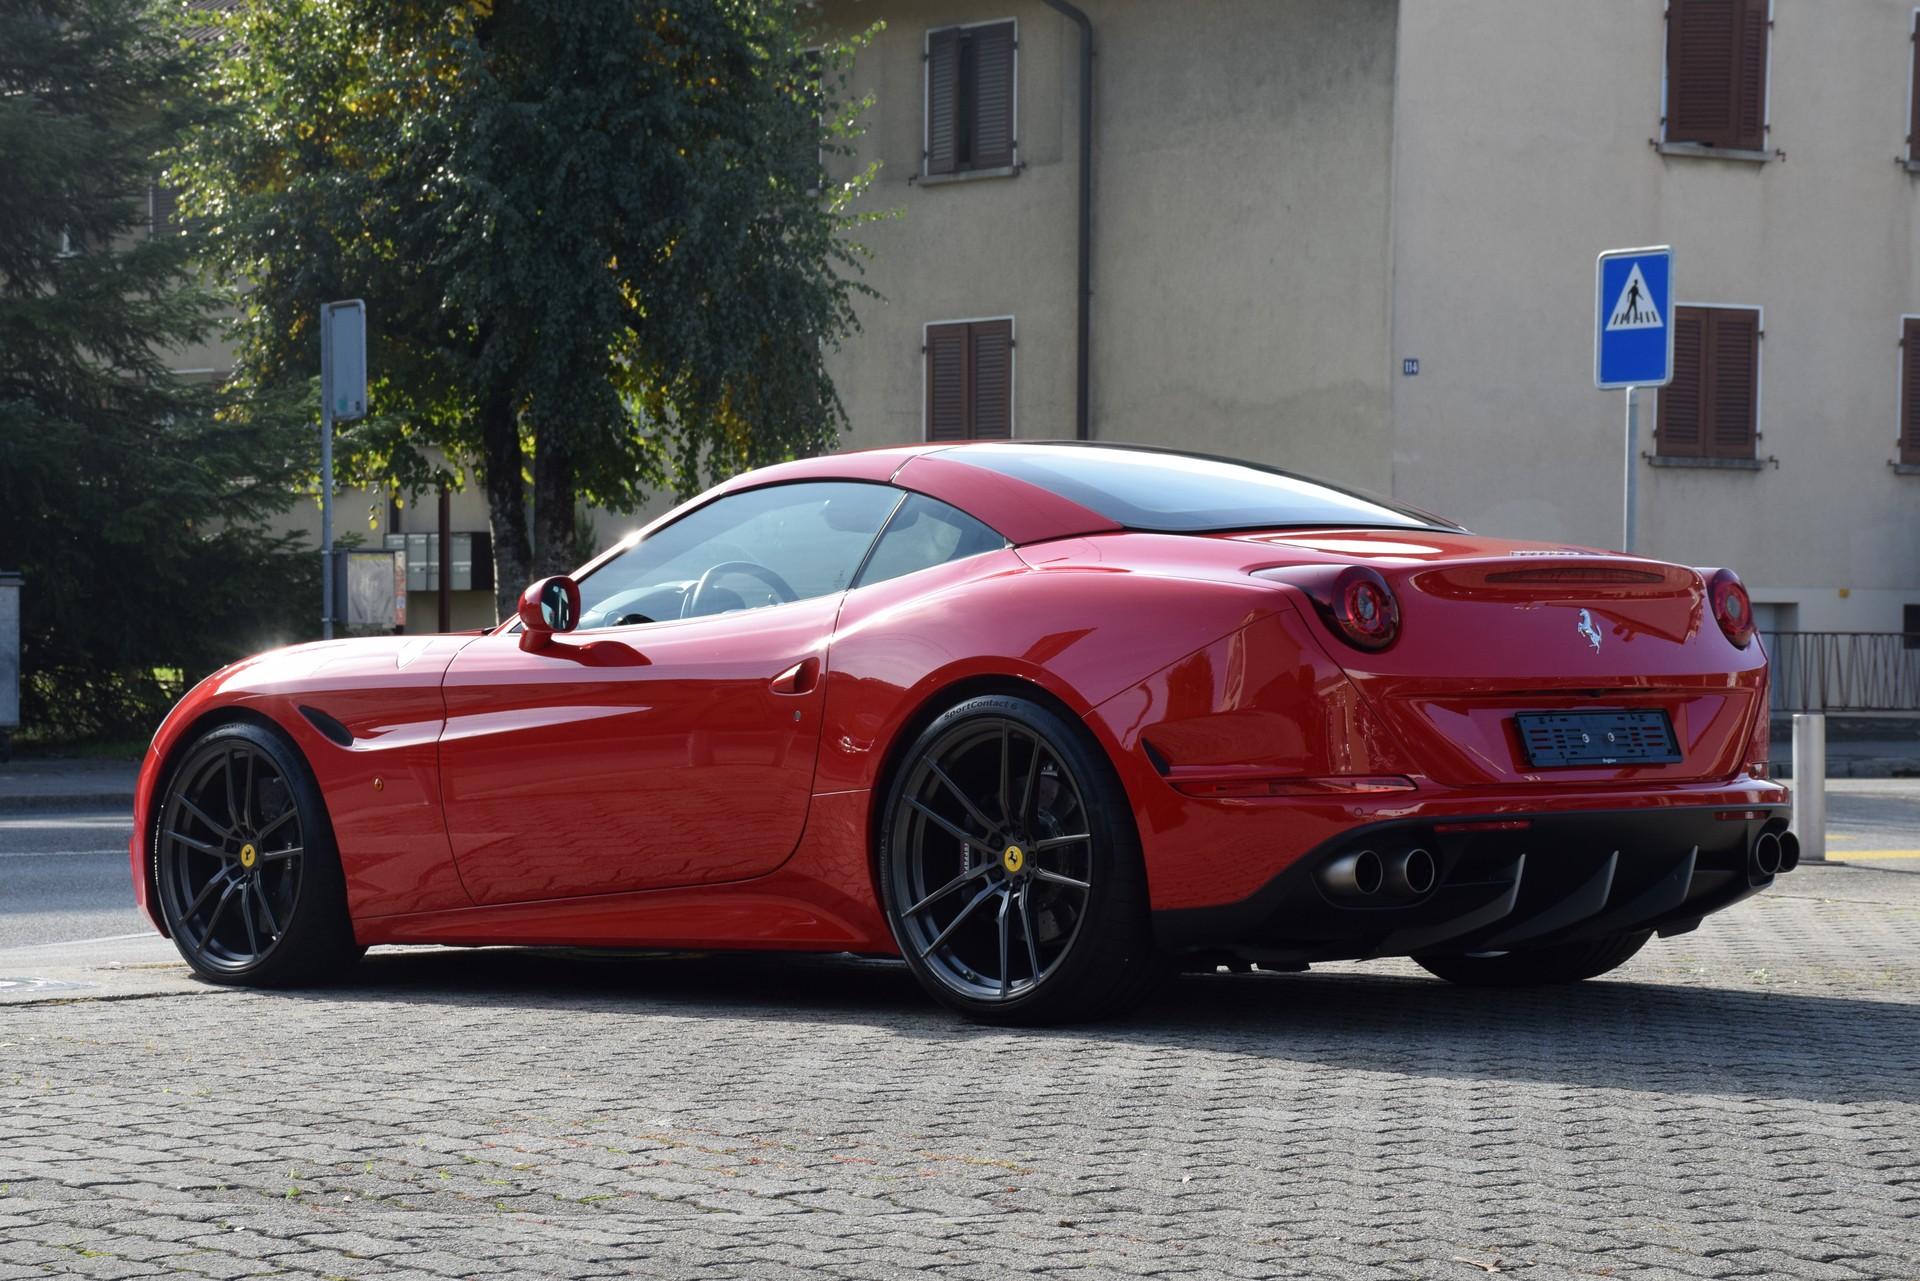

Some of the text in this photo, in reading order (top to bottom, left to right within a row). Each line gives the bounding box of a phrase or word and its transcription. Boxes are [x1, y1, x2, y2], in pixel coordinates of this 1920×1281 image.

[1405, 361, 1418, 373] 114
[944, 700, 1019, 720] SportContact 6
